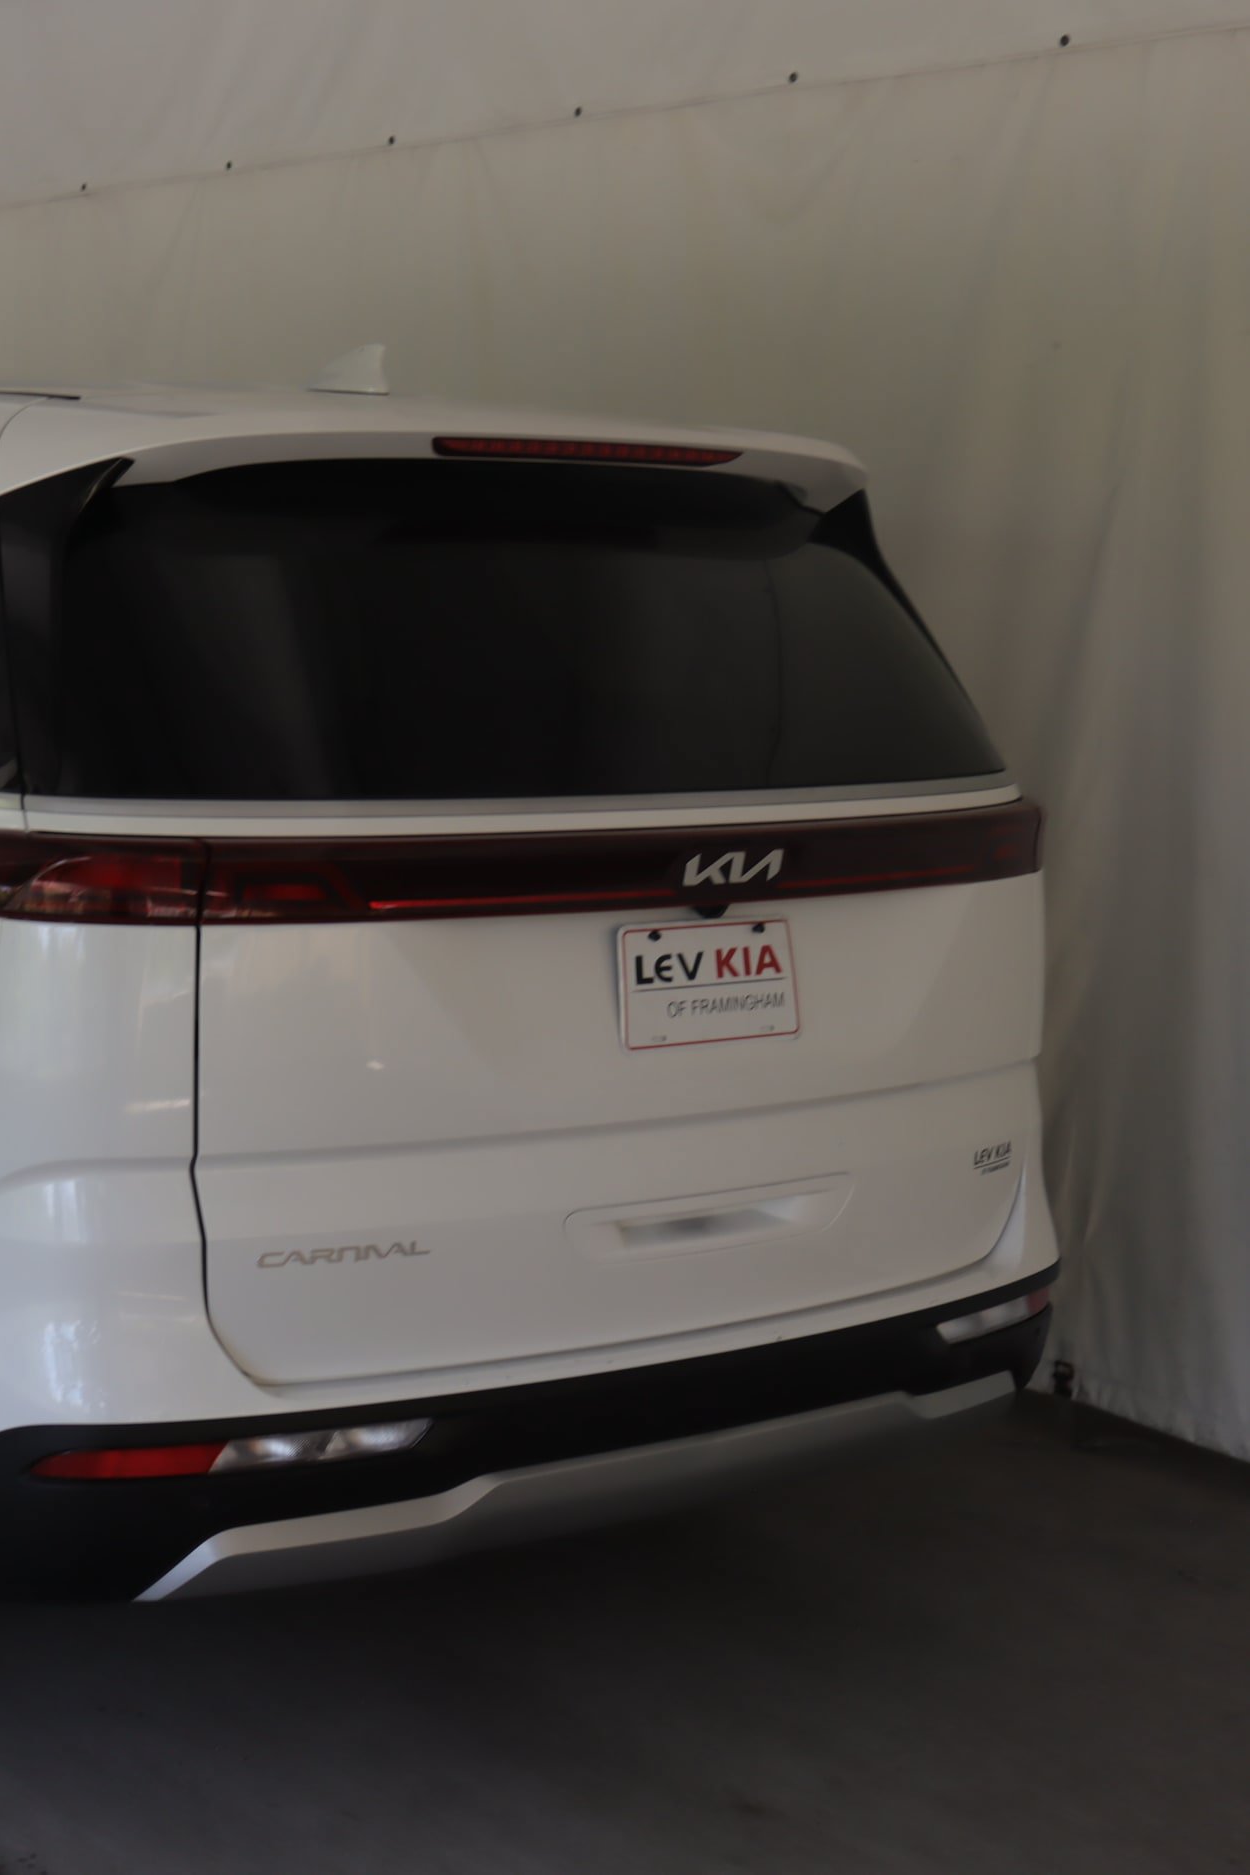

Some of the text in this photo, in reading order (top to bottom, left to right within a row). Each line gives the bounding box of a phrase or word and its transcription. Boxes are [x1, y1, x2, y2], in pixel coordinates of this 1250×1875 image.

[682, 848, 785, 886] KIA
[635, 944, 783, 985] LEV KIA
[667, 992, 785, 1018] OF FRAMINGHAM
[257, 1240, 431, 1268] CARNIVAL
